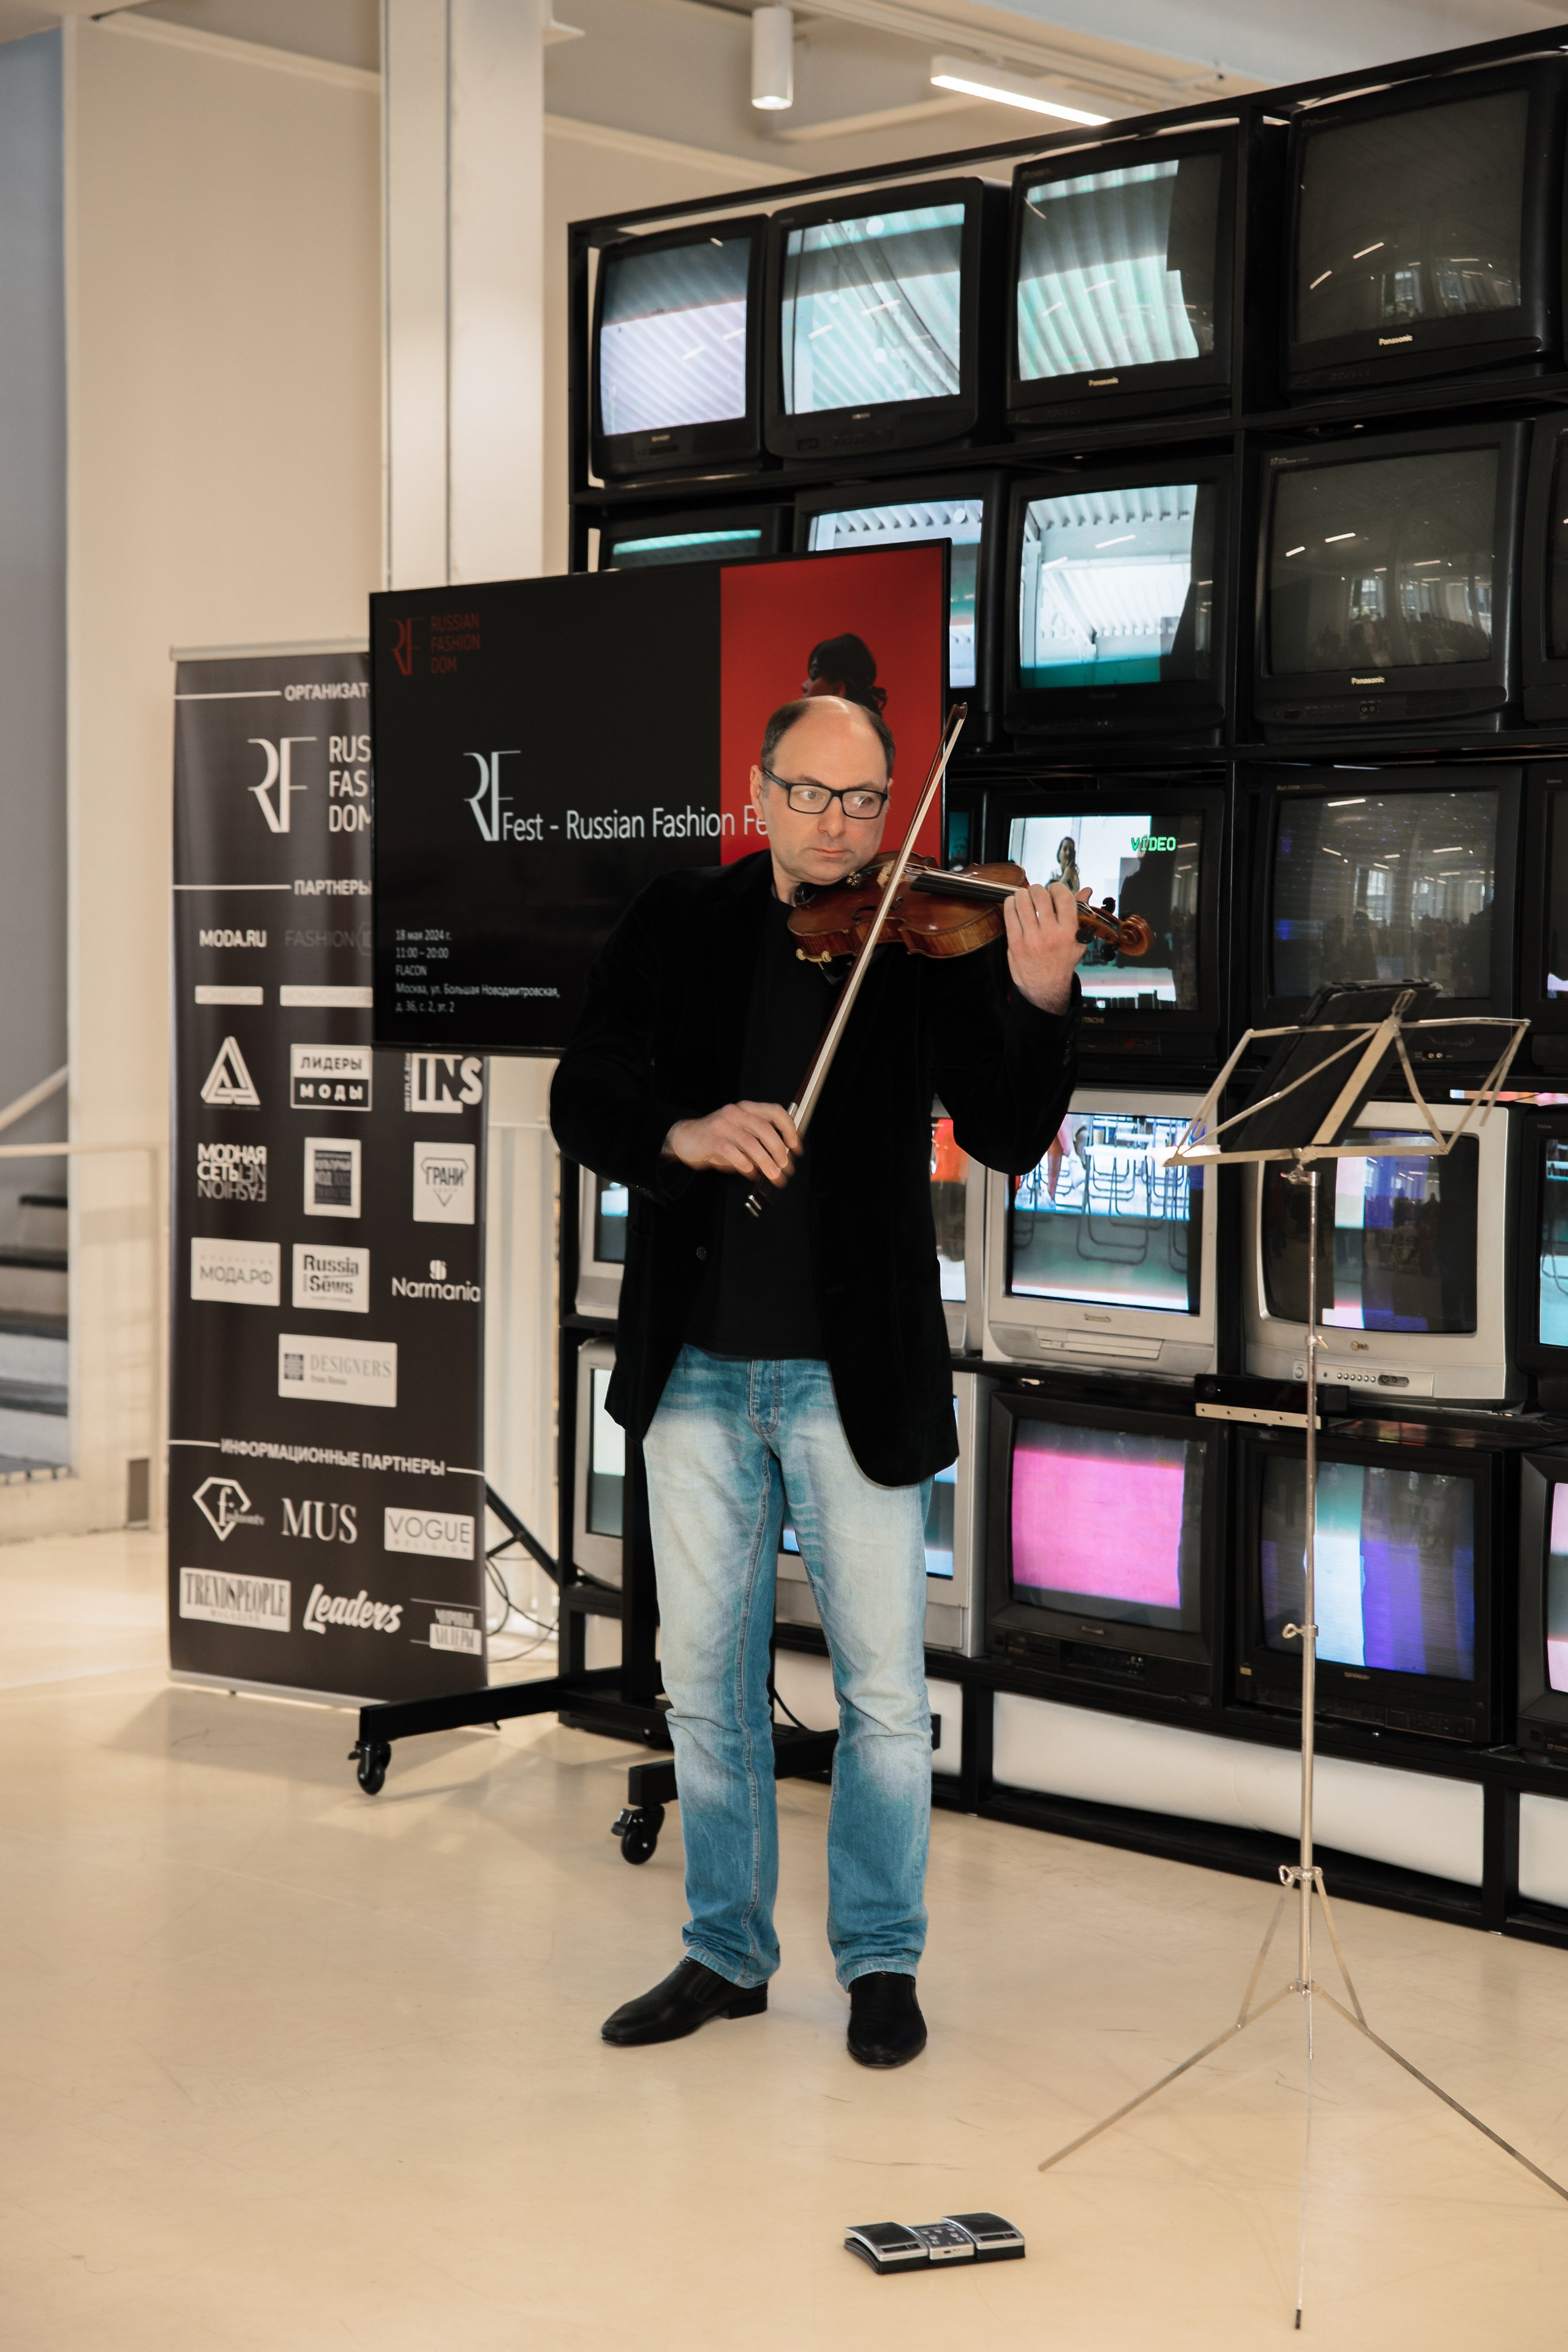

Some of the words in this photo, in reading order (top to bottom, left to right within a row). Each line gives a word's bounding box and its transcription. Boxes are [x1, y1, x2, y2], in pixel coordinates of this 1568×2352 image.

[1379, 333, 1413, 346] Panasonic
[1088, 376, 1119, 386] Panasonic
[431, 613, 480, 631] RUSSIAN
[431, 633, 481, 653] FASHION
[431, 656, 458, 674] DOM
[1351, 675, 1385, 685] Panasonic
[285, 682, 370, 701] ОРГАНИЗАТ
[503, 812, 543, 841] Fest
[567, 810, 644, 840] Russian
[653, 805, 734, 838] Fashion
[1131, 837, 1176, 851] VIDEO
[294, 879, 372, 895] ПАРТНЕРЫ
[199, 929, 267, 948] MODA.RU
[285, 929, 355, 947] FASHION
[396, 929, 405, 941] 18
[407, 932, 423, 941] мая
[424, 929, 444, 941] 2024
[396, 948, 418, 958] 11:00
[426, 948, 449, 959] 20:00
[396, 965, 427, 976] FLACON
[396, 983, 428, 995] Москва,
[443, 983, 480, 995] Большая
[482, 984, 560, 998] Новодмитровская,
[450, 1001, 454, 1012] 2
[300, 1055, 363, 1071] ЛИДЕРЫ
[300, 1082, 363, 1101] МОДЫ
[197, 1143, 267, 1165] МОДНАЯ
[197, 1161, 239, 1182] СЕТЬ
[426, 1166, 464, 1186] ГРАНИ
[303, 1254, 359, 1275] Russia
[199, 1265, 273, 1286] МОДА.РФ
[310, 1275, 354, 1294] Sews
[391, 1276, 481, 1303] Narmania
[1083, 1313, 1112, 1323] Panasonic
[311, 1354, 391, 1378] DESIGNERS
[221, 1438, 360, 1468] ИНФОРМАЦИОННЫЕ
[363, 1453, 446, 1476] ПАРТНЕРЫ
[281, 1497, 358, 1545] MUS
[388, 1515, 470, 1544] VOGUE
[303, 1583, 404, 1635] Leaders
[1343, 1671, 1371, 1680] SHARP
